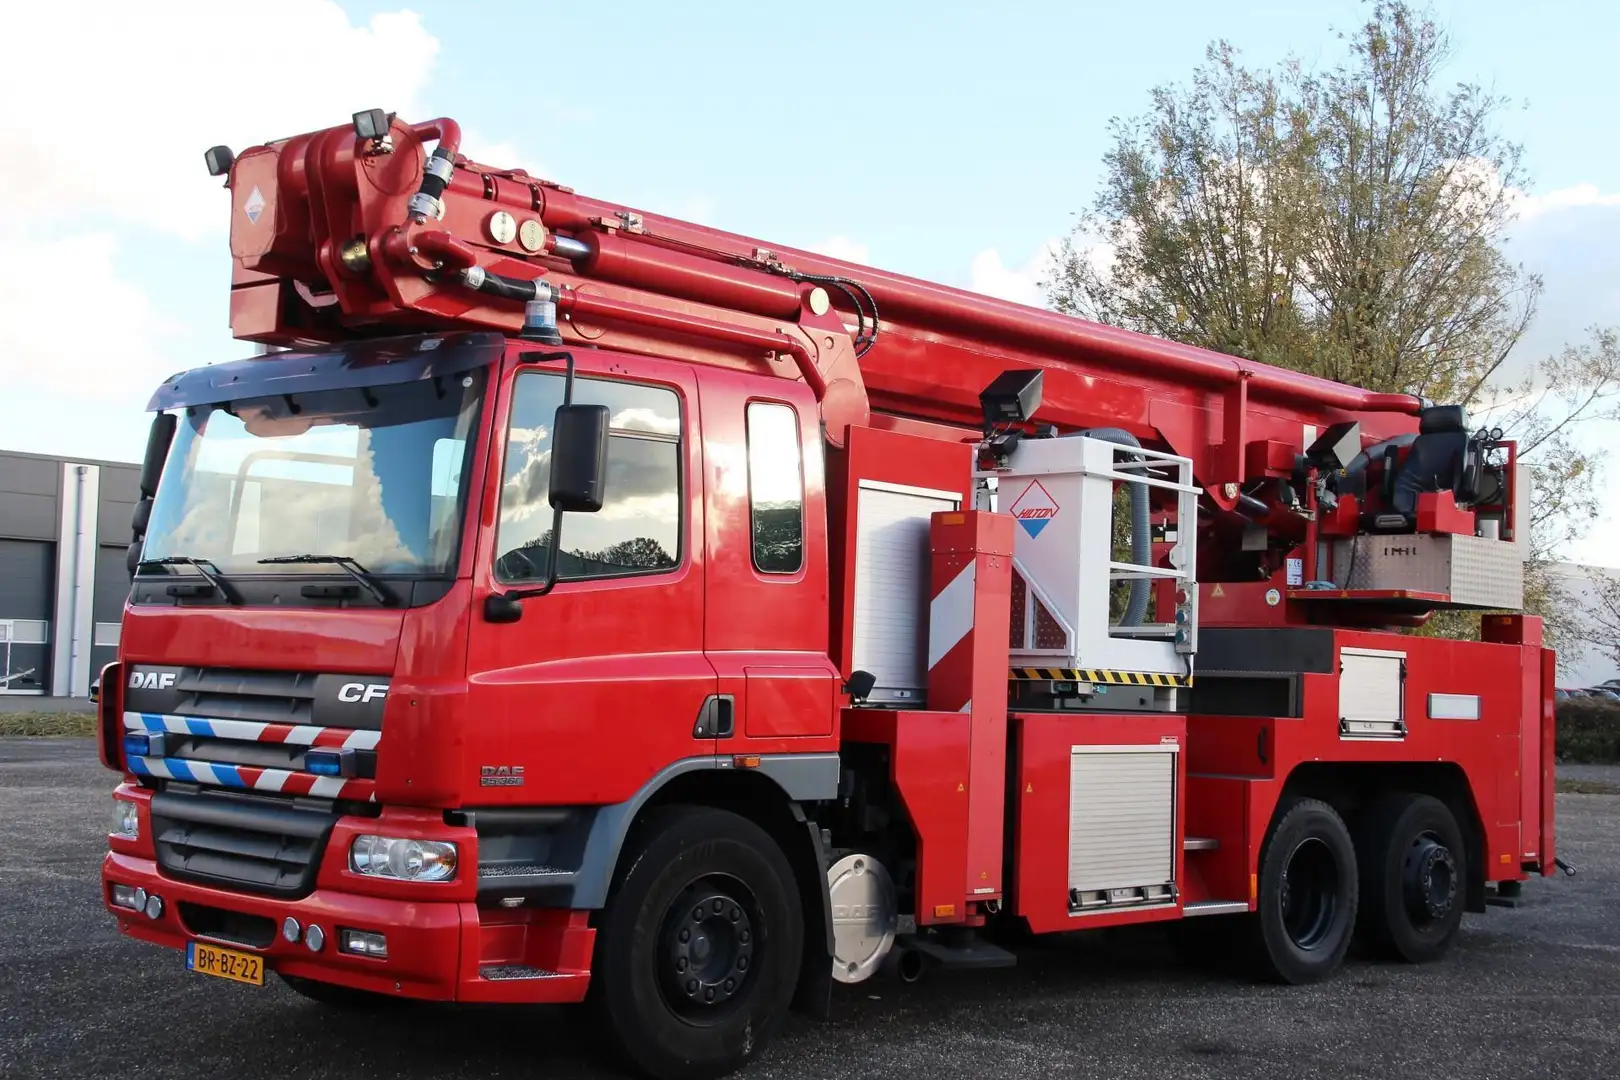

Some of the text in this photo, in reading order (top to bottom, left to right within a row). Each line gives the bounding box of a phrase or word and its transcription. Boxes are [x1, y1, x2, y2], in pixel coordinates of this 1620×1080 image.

[1018, 508, 1054, 518] HILTON
[128, 671, 176, 689] DAF
[338, 683, 390, 702] CF
[481, 765, 524, 776] DAF
[834, 904, 880, 918] DAF
[199, 948, 258, 980] BR-BZ-22
